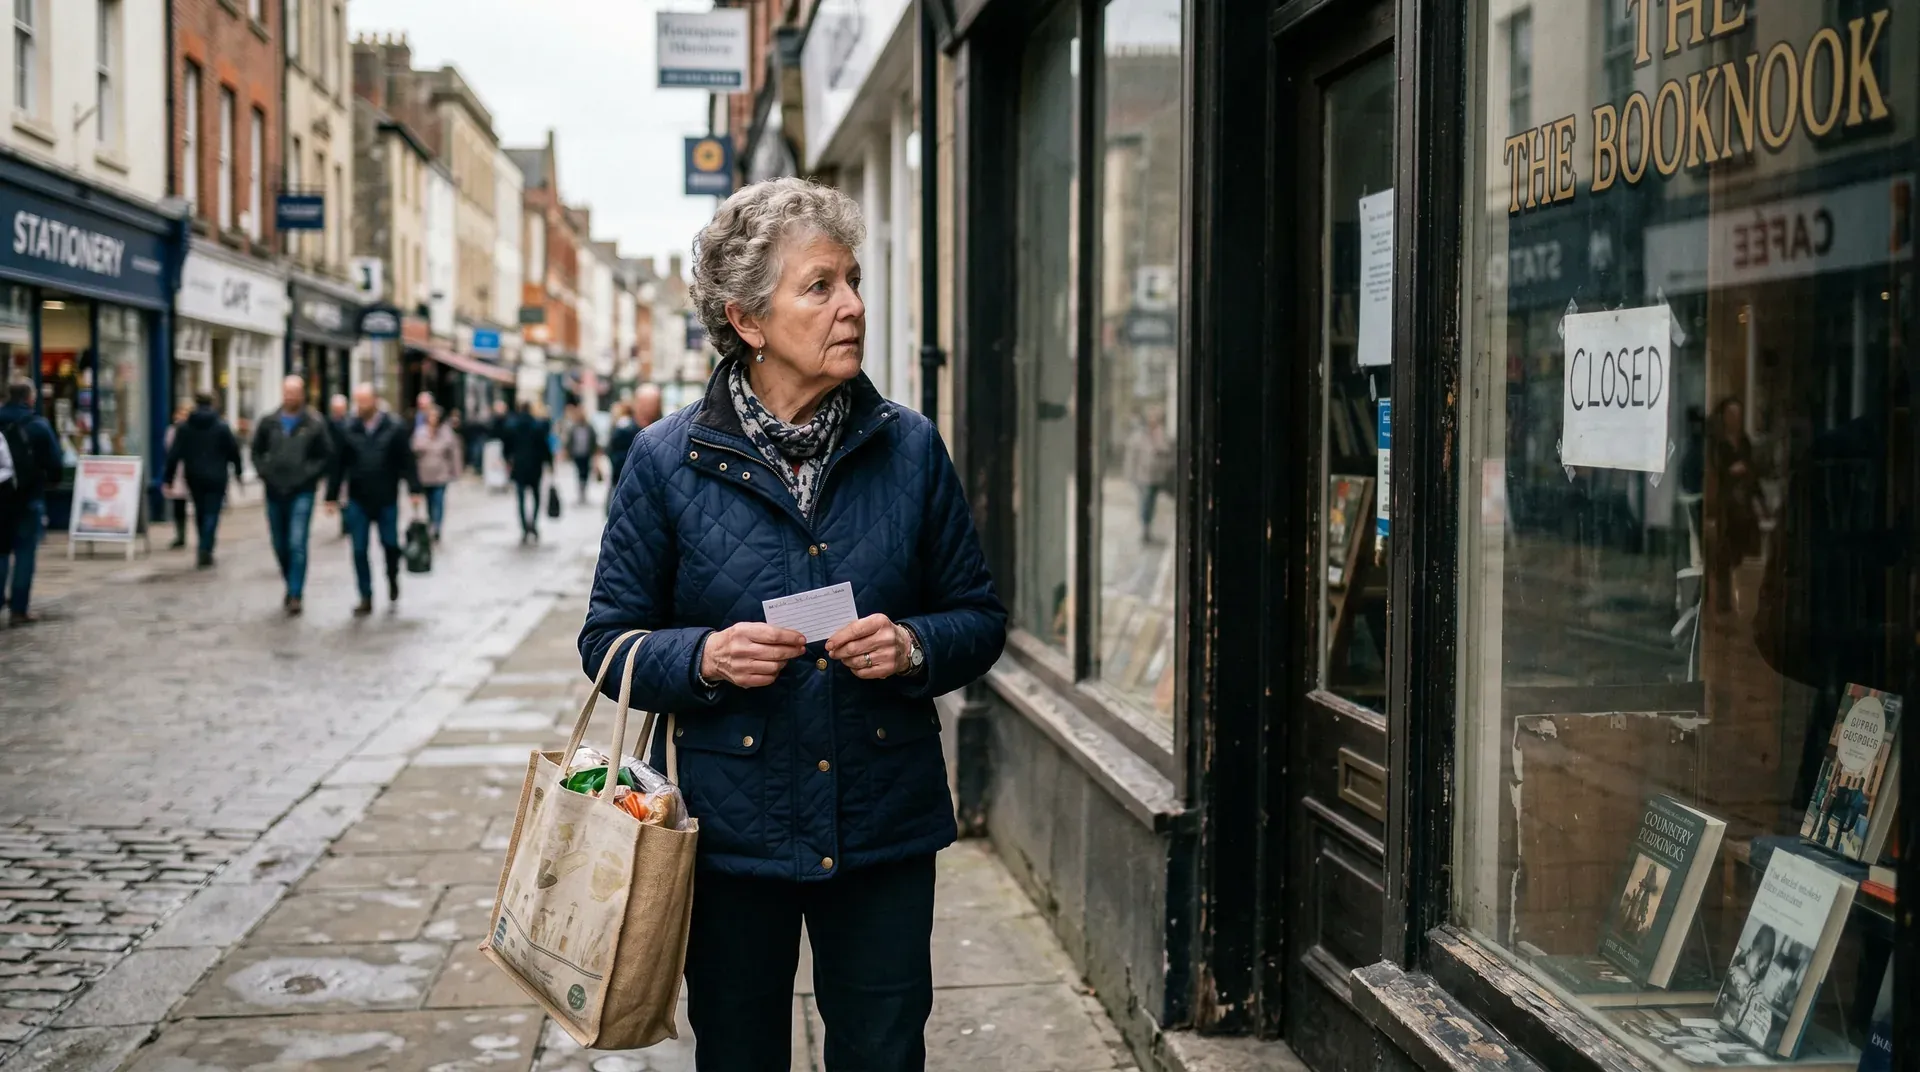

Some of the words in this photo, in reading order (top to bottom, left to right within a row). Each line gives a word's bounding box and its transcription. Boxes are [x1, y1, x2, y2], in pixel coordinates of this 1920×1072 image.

[1627, 0, 1746, 67] THE
[1505, 115, 1576, 212] THE
[1591, 9, 1890, 192] BOOKNOOK
[13, 210, 125, 278] STATIONERY
[1570, 346, 1663, 411] CLOSED
